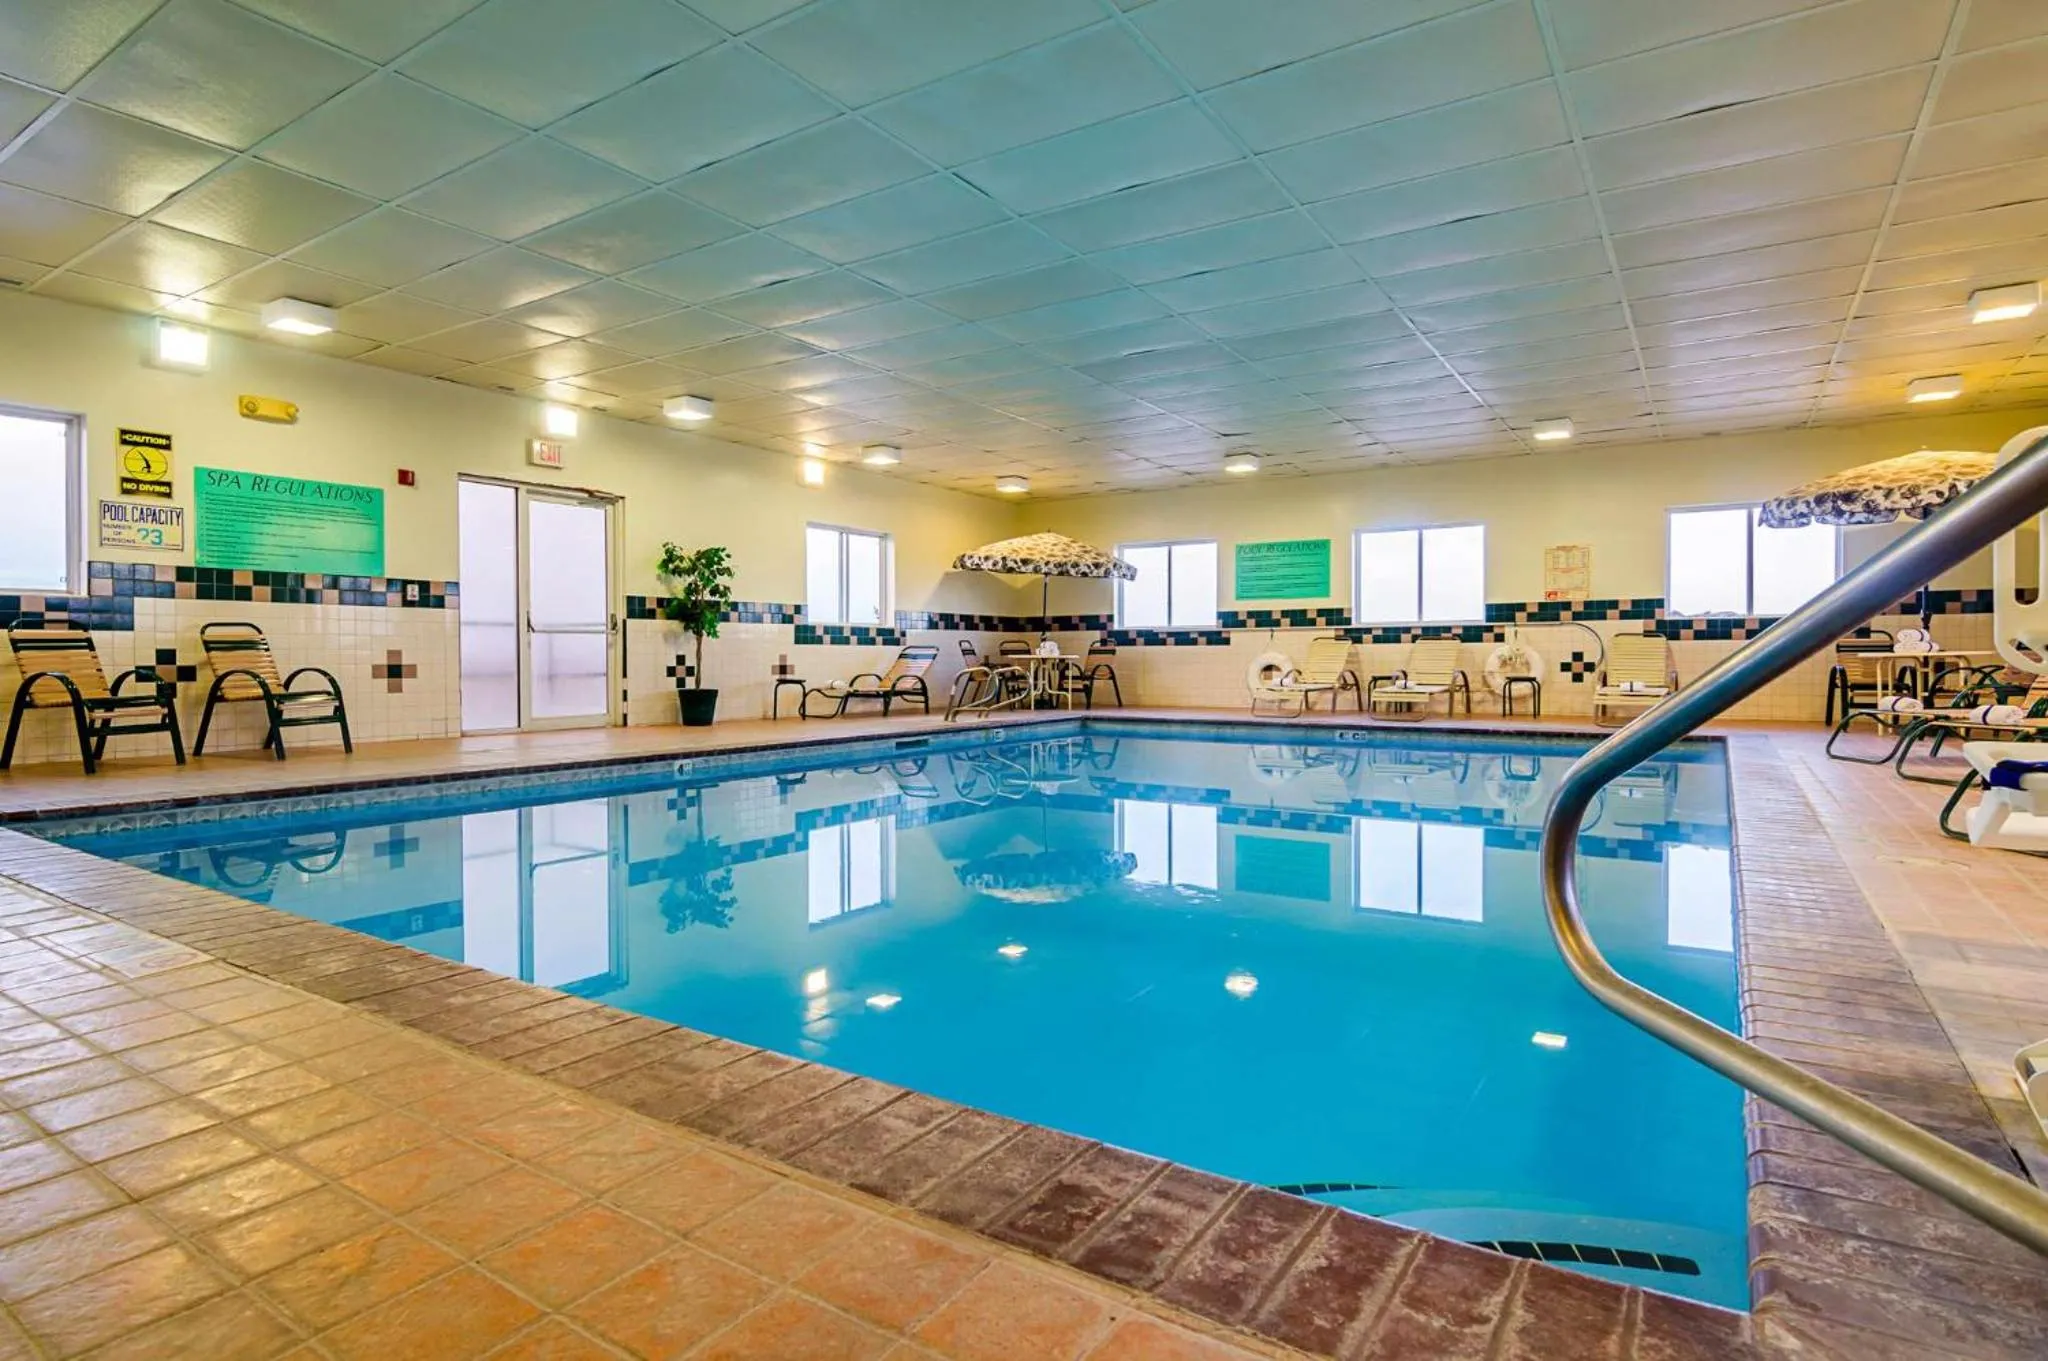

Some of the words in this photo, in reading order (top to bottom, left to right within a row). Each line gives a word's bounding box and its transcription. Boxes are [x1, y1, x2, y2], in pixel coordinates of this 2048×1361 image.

[126, 434, 167, 445] CAUTION
[540, 442, 561, 464] EXIT
[122, 482, 138, 490] NO
[138, 483, 170, 493] DIVING
[206, 470, 242, 490] SPA
[251, 475, 374, 504] REGULATIONS
[103, 503, 129, 522] POOL
[131, 505, 181, 526] CAPACITY
